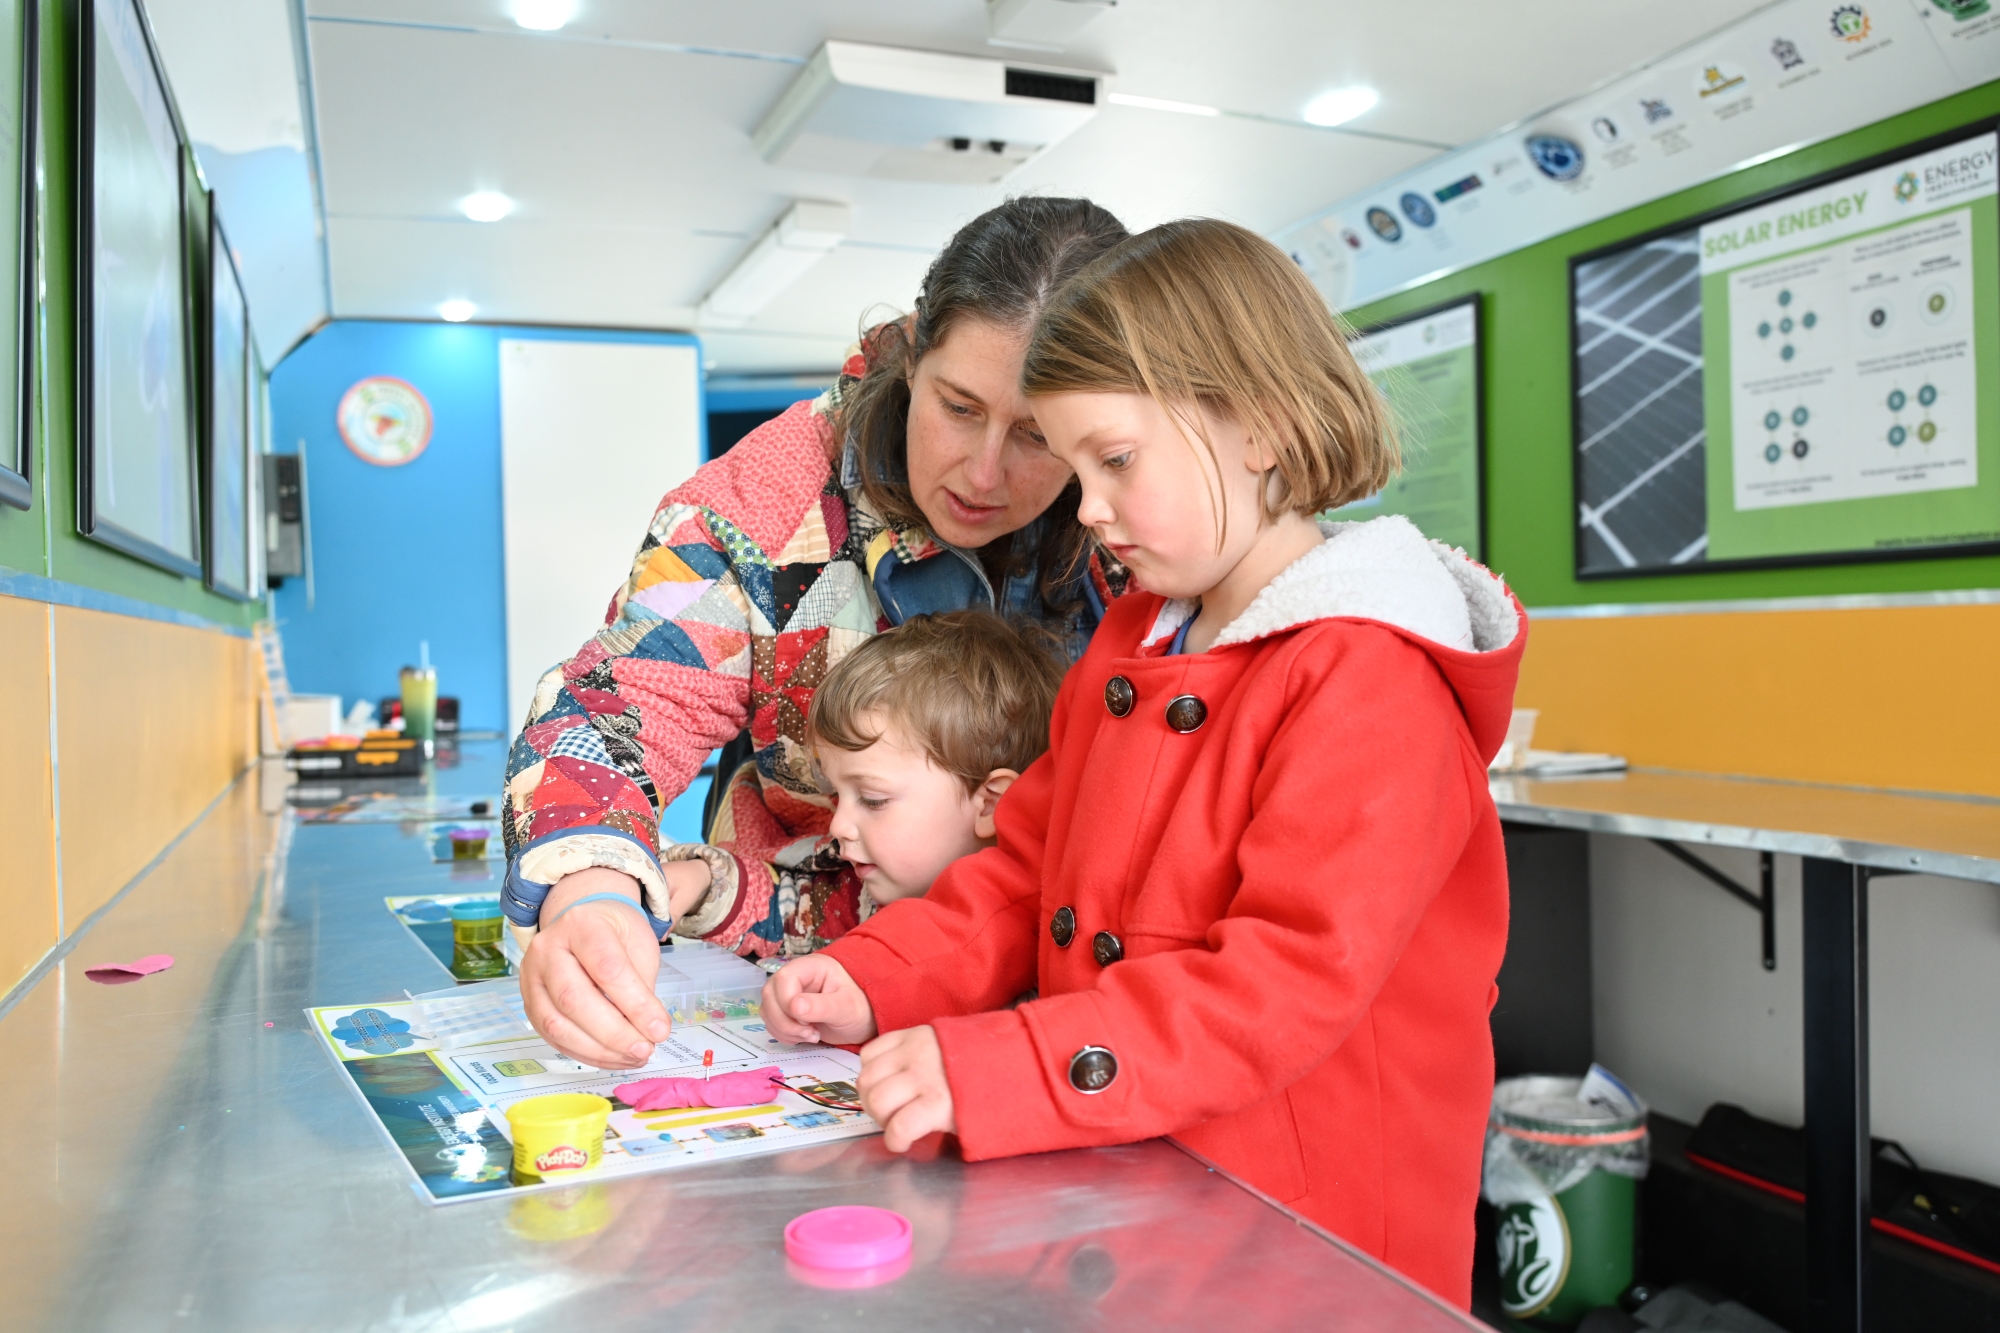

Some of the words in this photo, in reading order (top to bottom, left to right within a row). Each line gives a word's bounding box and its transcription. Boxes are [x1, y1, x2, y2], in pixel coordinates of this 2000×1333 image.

[1924, 145, 1997, 185] ENERGY
[1704, 220, 1771, 258] SOLAR
[1776, 189, 1867, 237] ENERGY
[480, 1072, 499, 1084] Vocab
